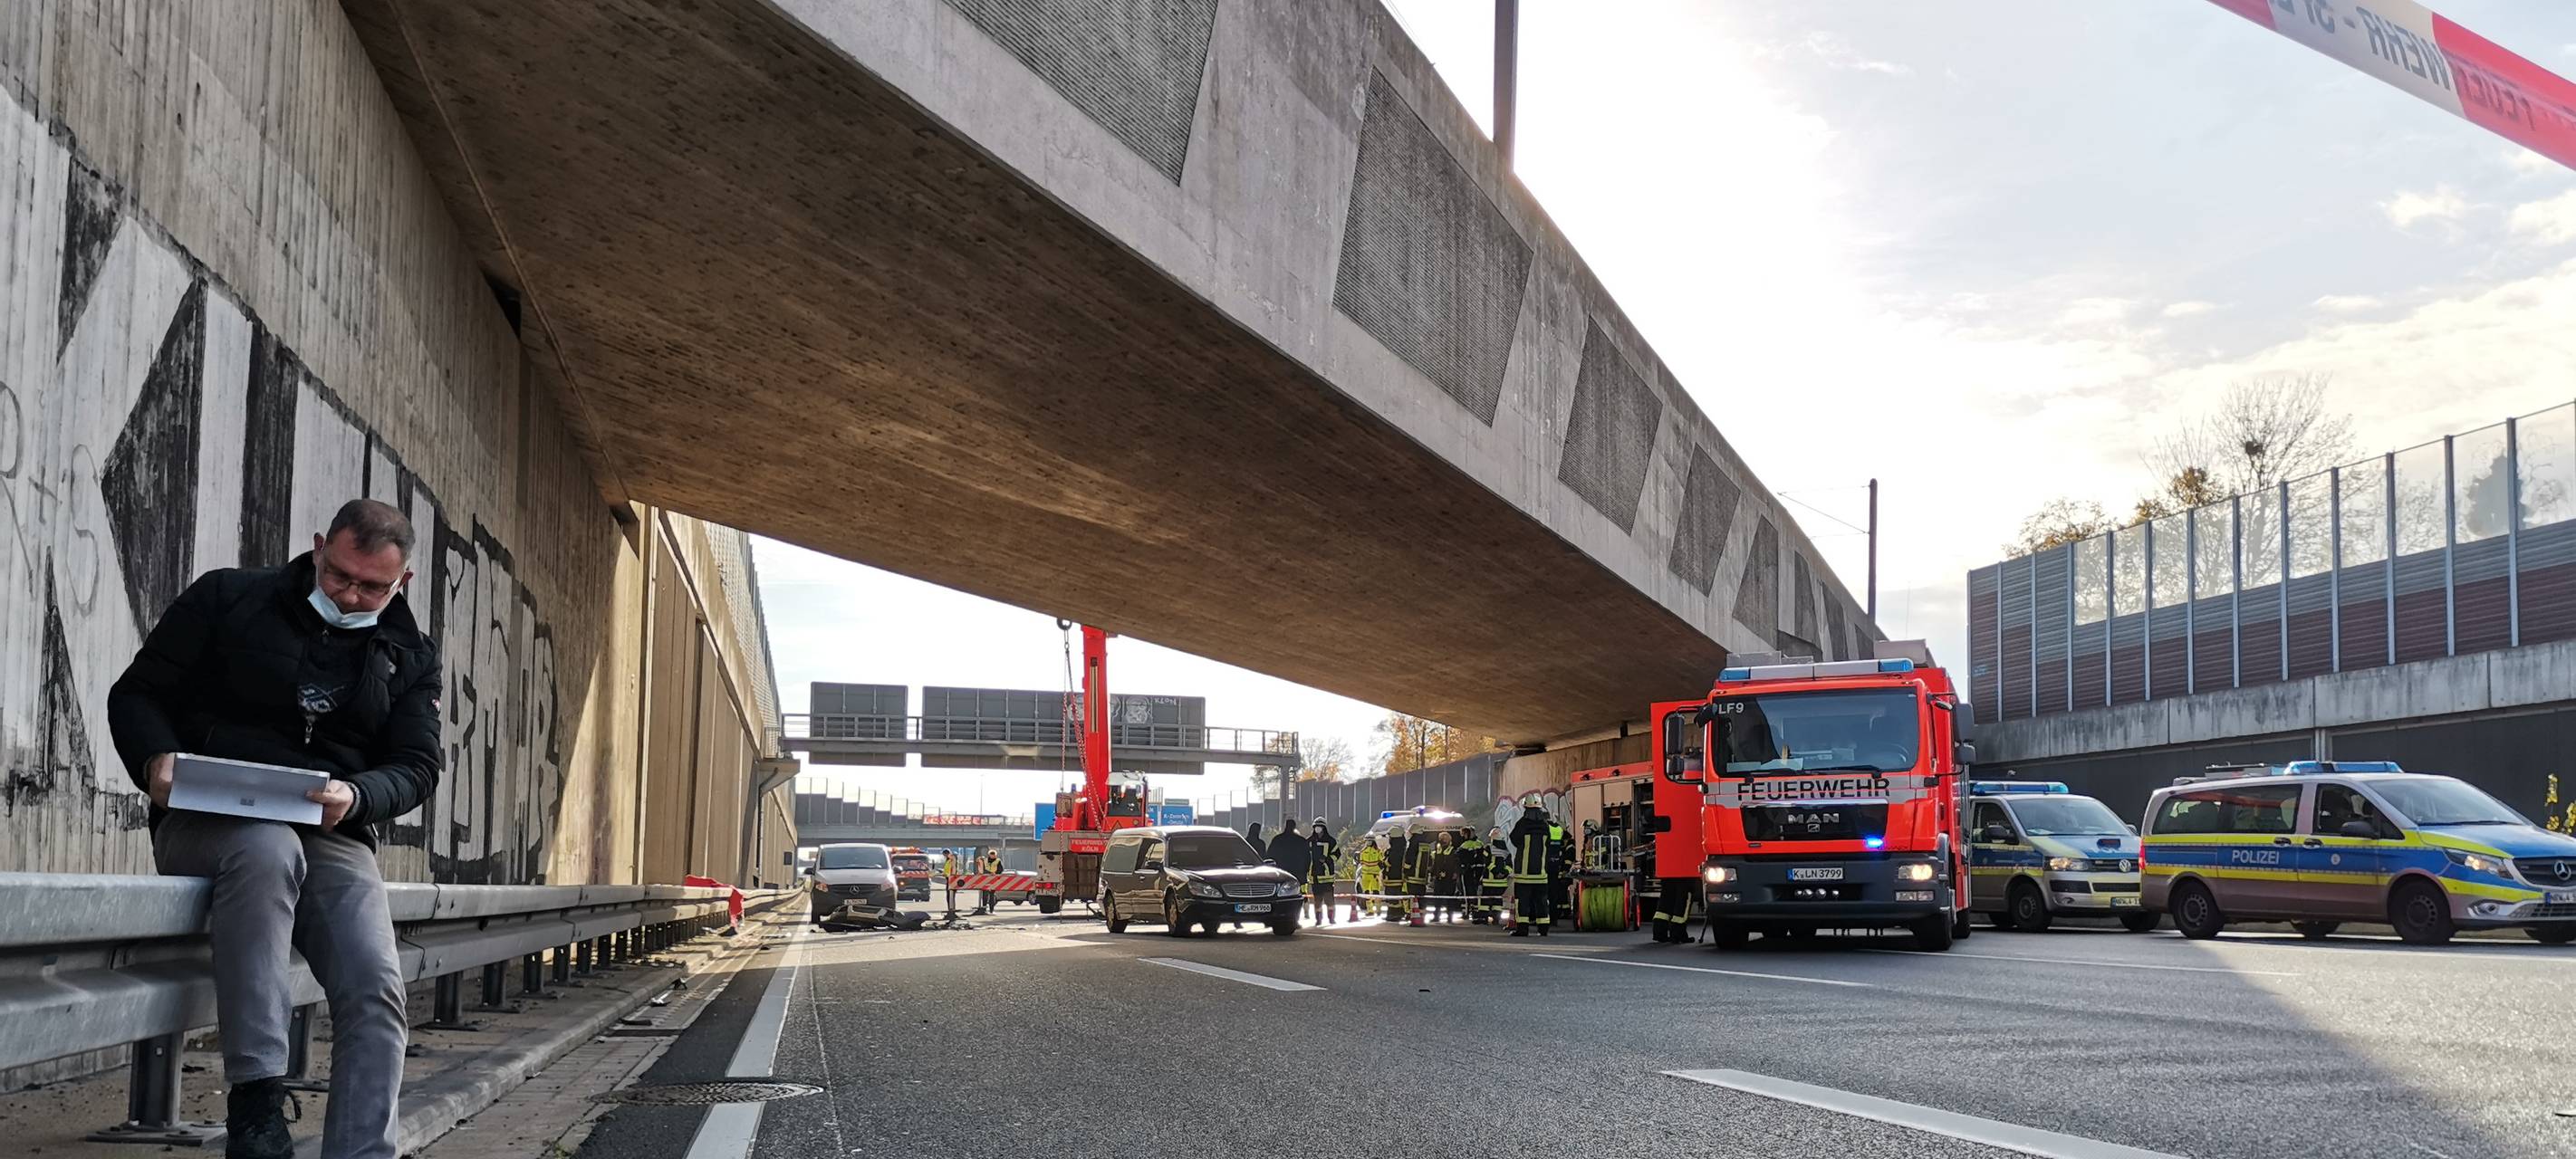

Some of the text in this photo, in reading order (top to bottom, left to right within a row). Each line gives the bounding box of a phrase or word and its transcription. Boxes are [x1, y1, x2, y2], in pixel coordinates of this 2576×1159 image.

[1718, 703, 1745, 714] LF9
[1737, 778, 1890, 801] FEUERWEHR
[1788, 813, 1840, 824] MAN
[2232, 849, 2280, 865] POLIZEI
